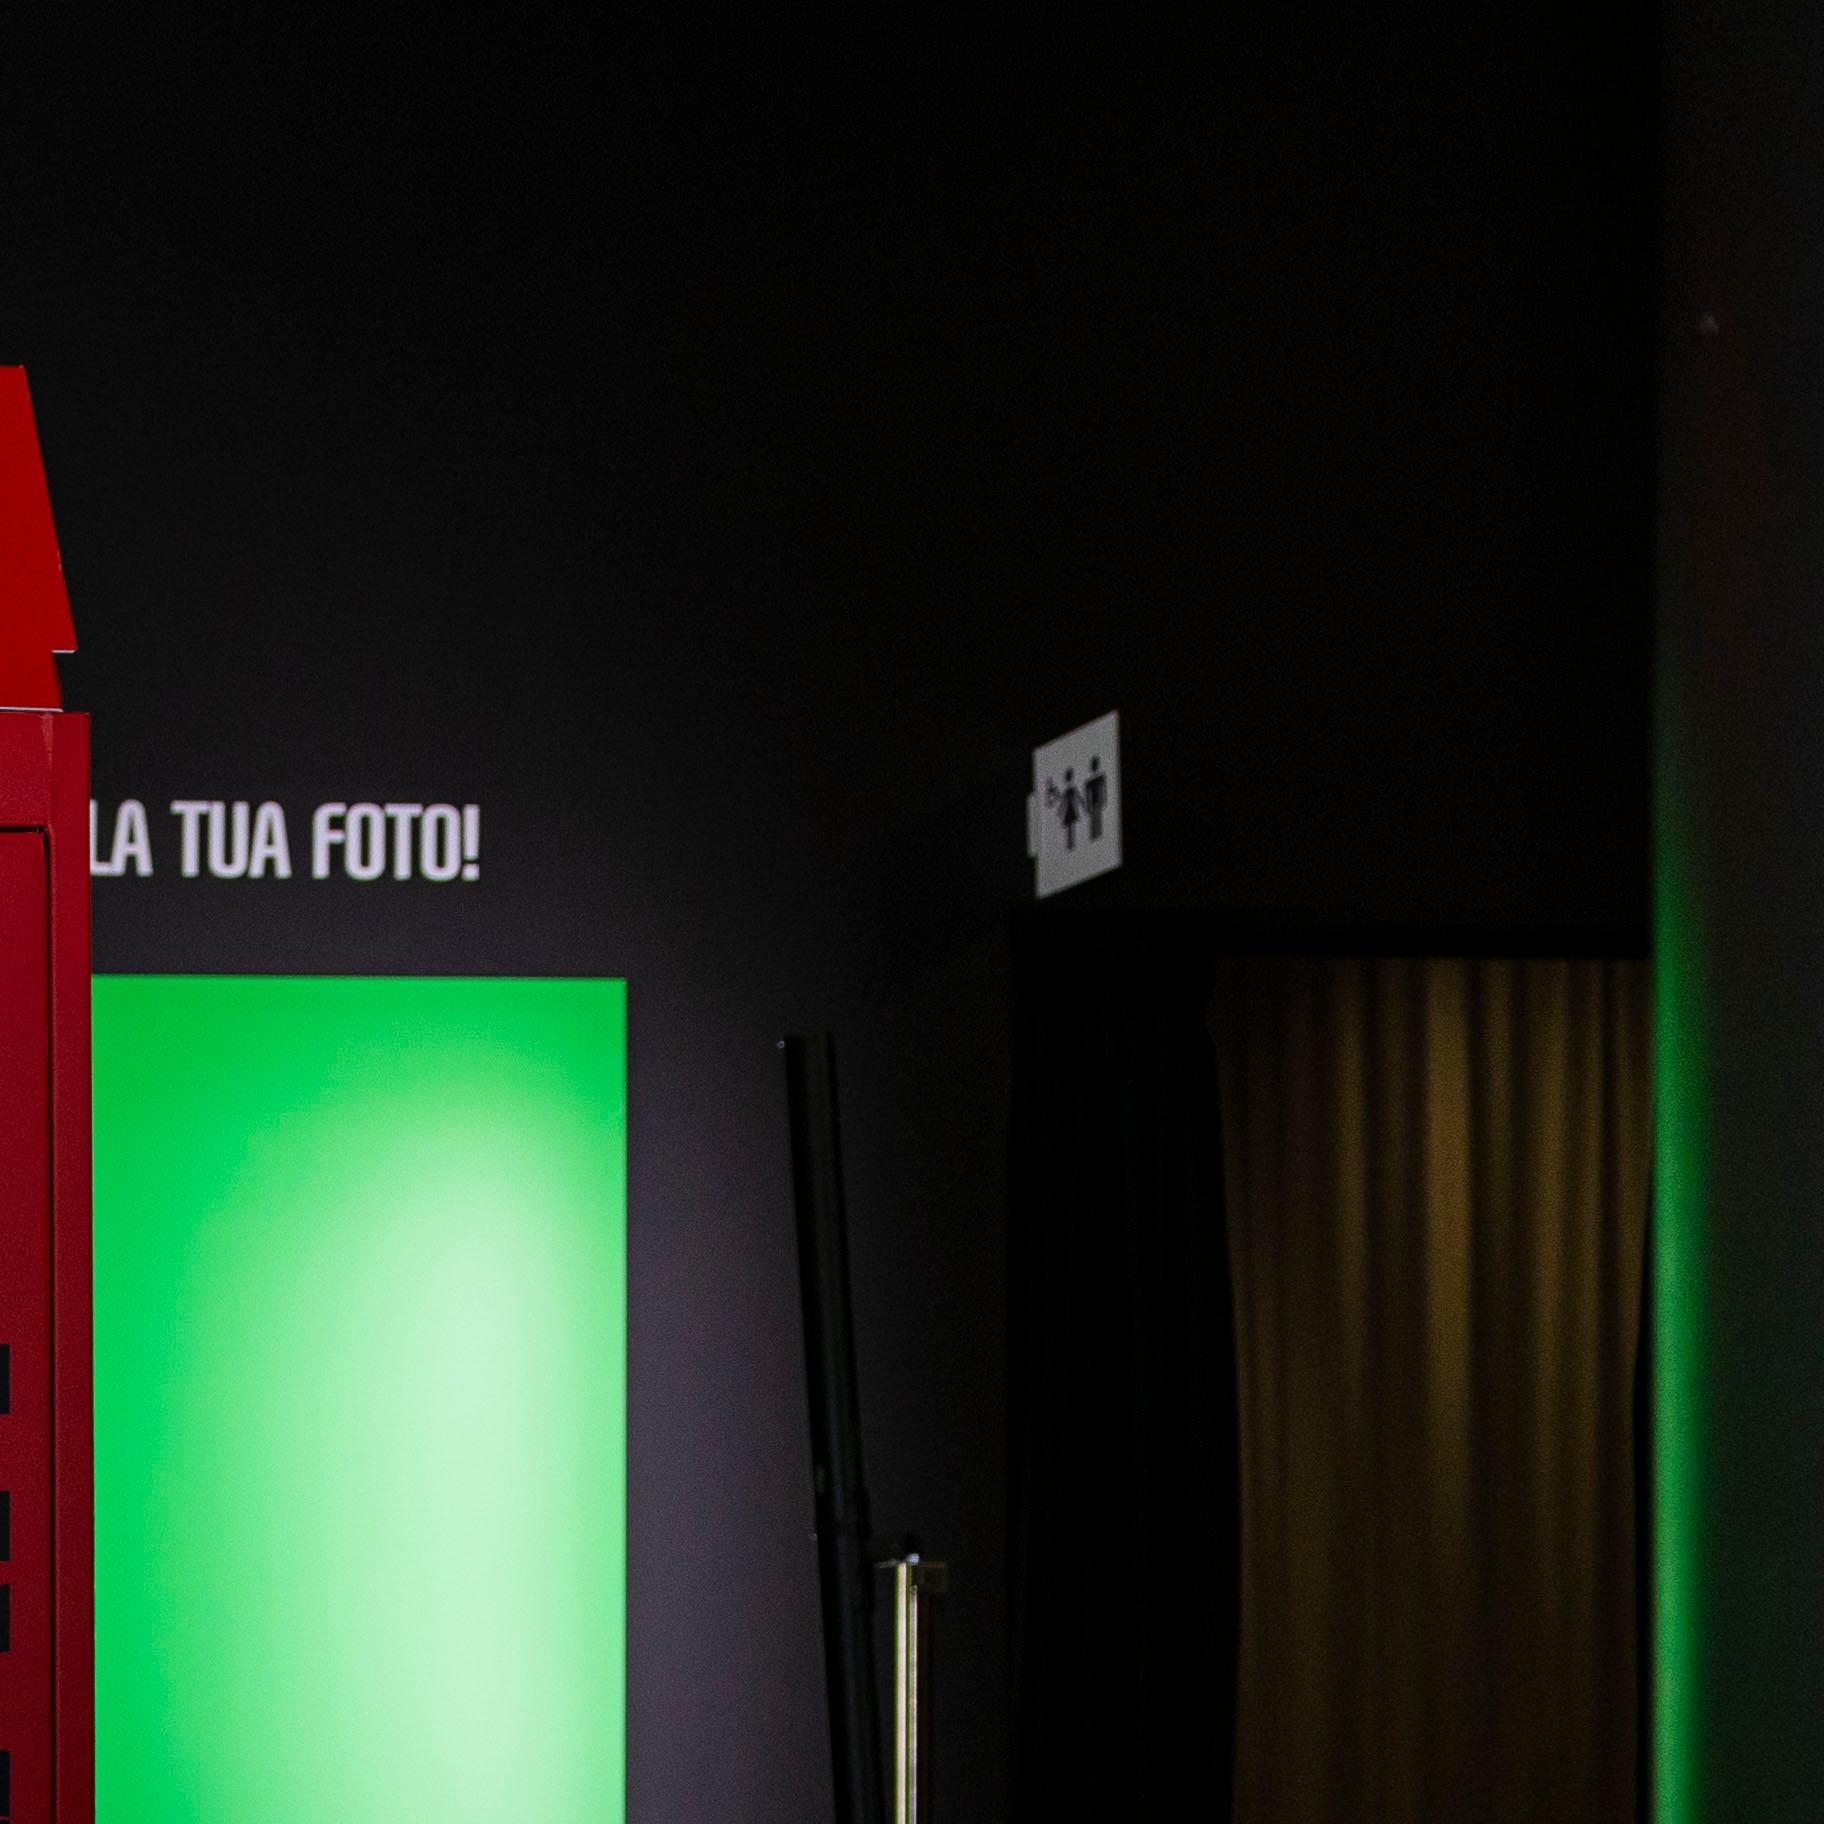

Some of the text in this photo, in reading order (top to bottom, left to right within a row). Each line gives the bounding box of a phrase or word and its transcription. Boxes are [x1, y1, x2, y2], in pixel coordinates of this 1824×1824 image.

[89, 798, 481, 883] LA TUA FOTO!
